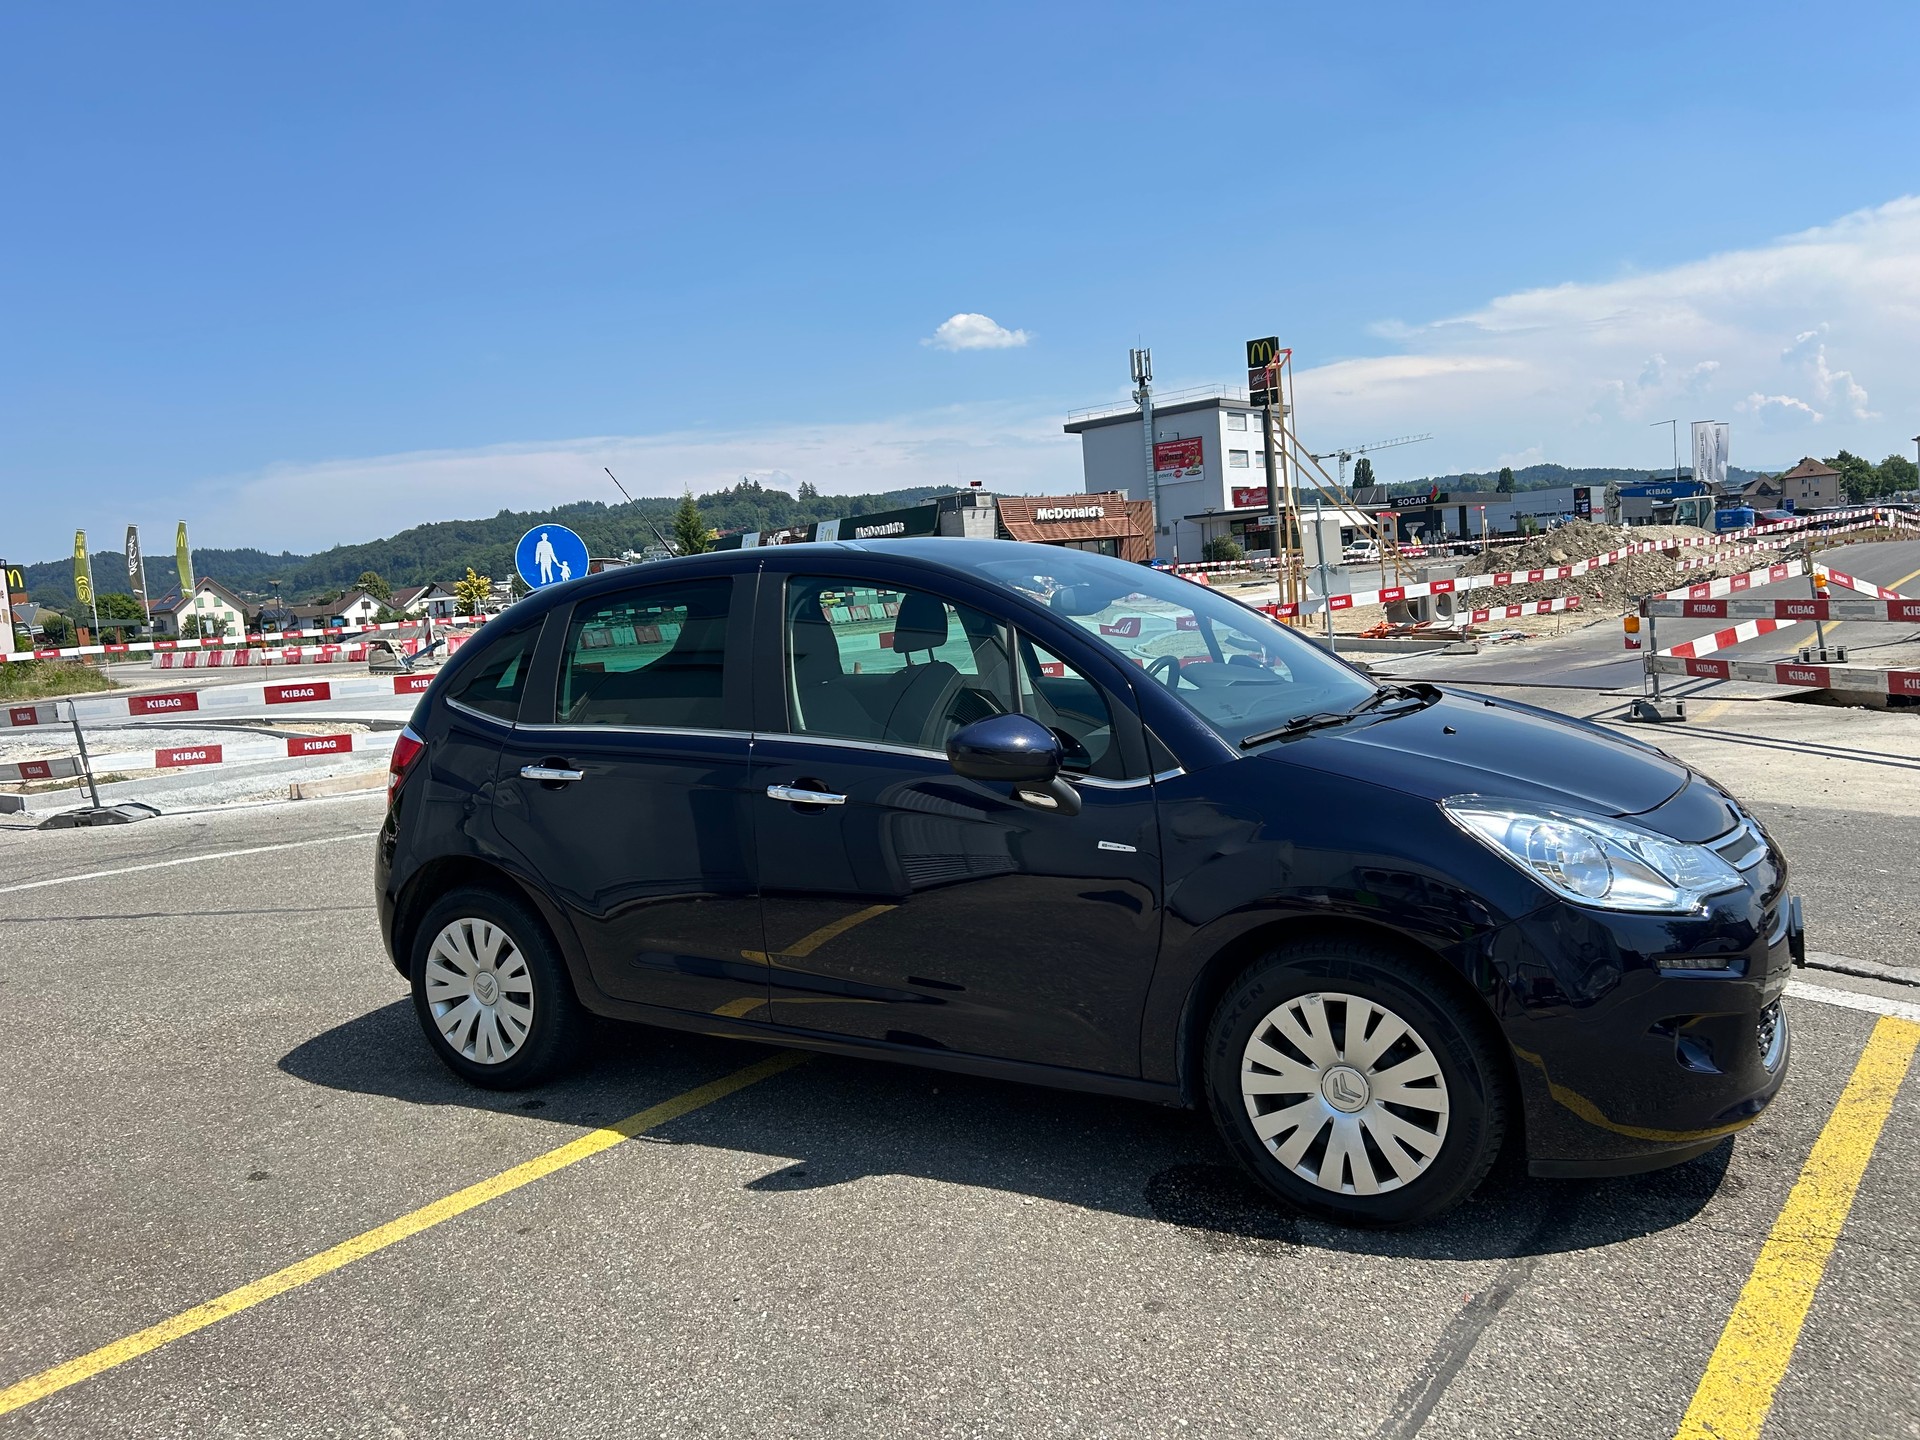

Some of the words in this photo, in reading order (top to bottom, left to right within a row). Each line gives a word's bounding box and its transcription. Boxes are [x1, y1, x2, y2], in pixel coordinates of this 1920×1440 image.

[1645, 487, 1673, 496] KIBAG
[1397, 496, 1428, 507] SOCAR
[1036, 505, 1105, 520] McDonald's
[1693, 603, 1717, 613] KIBAG
[1787, 604, 1816, 615] KIBAG
[1695, 663, 1719, 674] KIBAG
[1788, 670, 1817, 682] KIBAG
[281, 688, 315, 699] KIBAG
[146, 697, 182, 709] KIBAG
[16, 712, 31, 721] KIBAG
[303, 739, 337, 751] KIBAG
[172, 750, 207, 762] KIBAG
[26, 765, 44, 775] KIBAG
